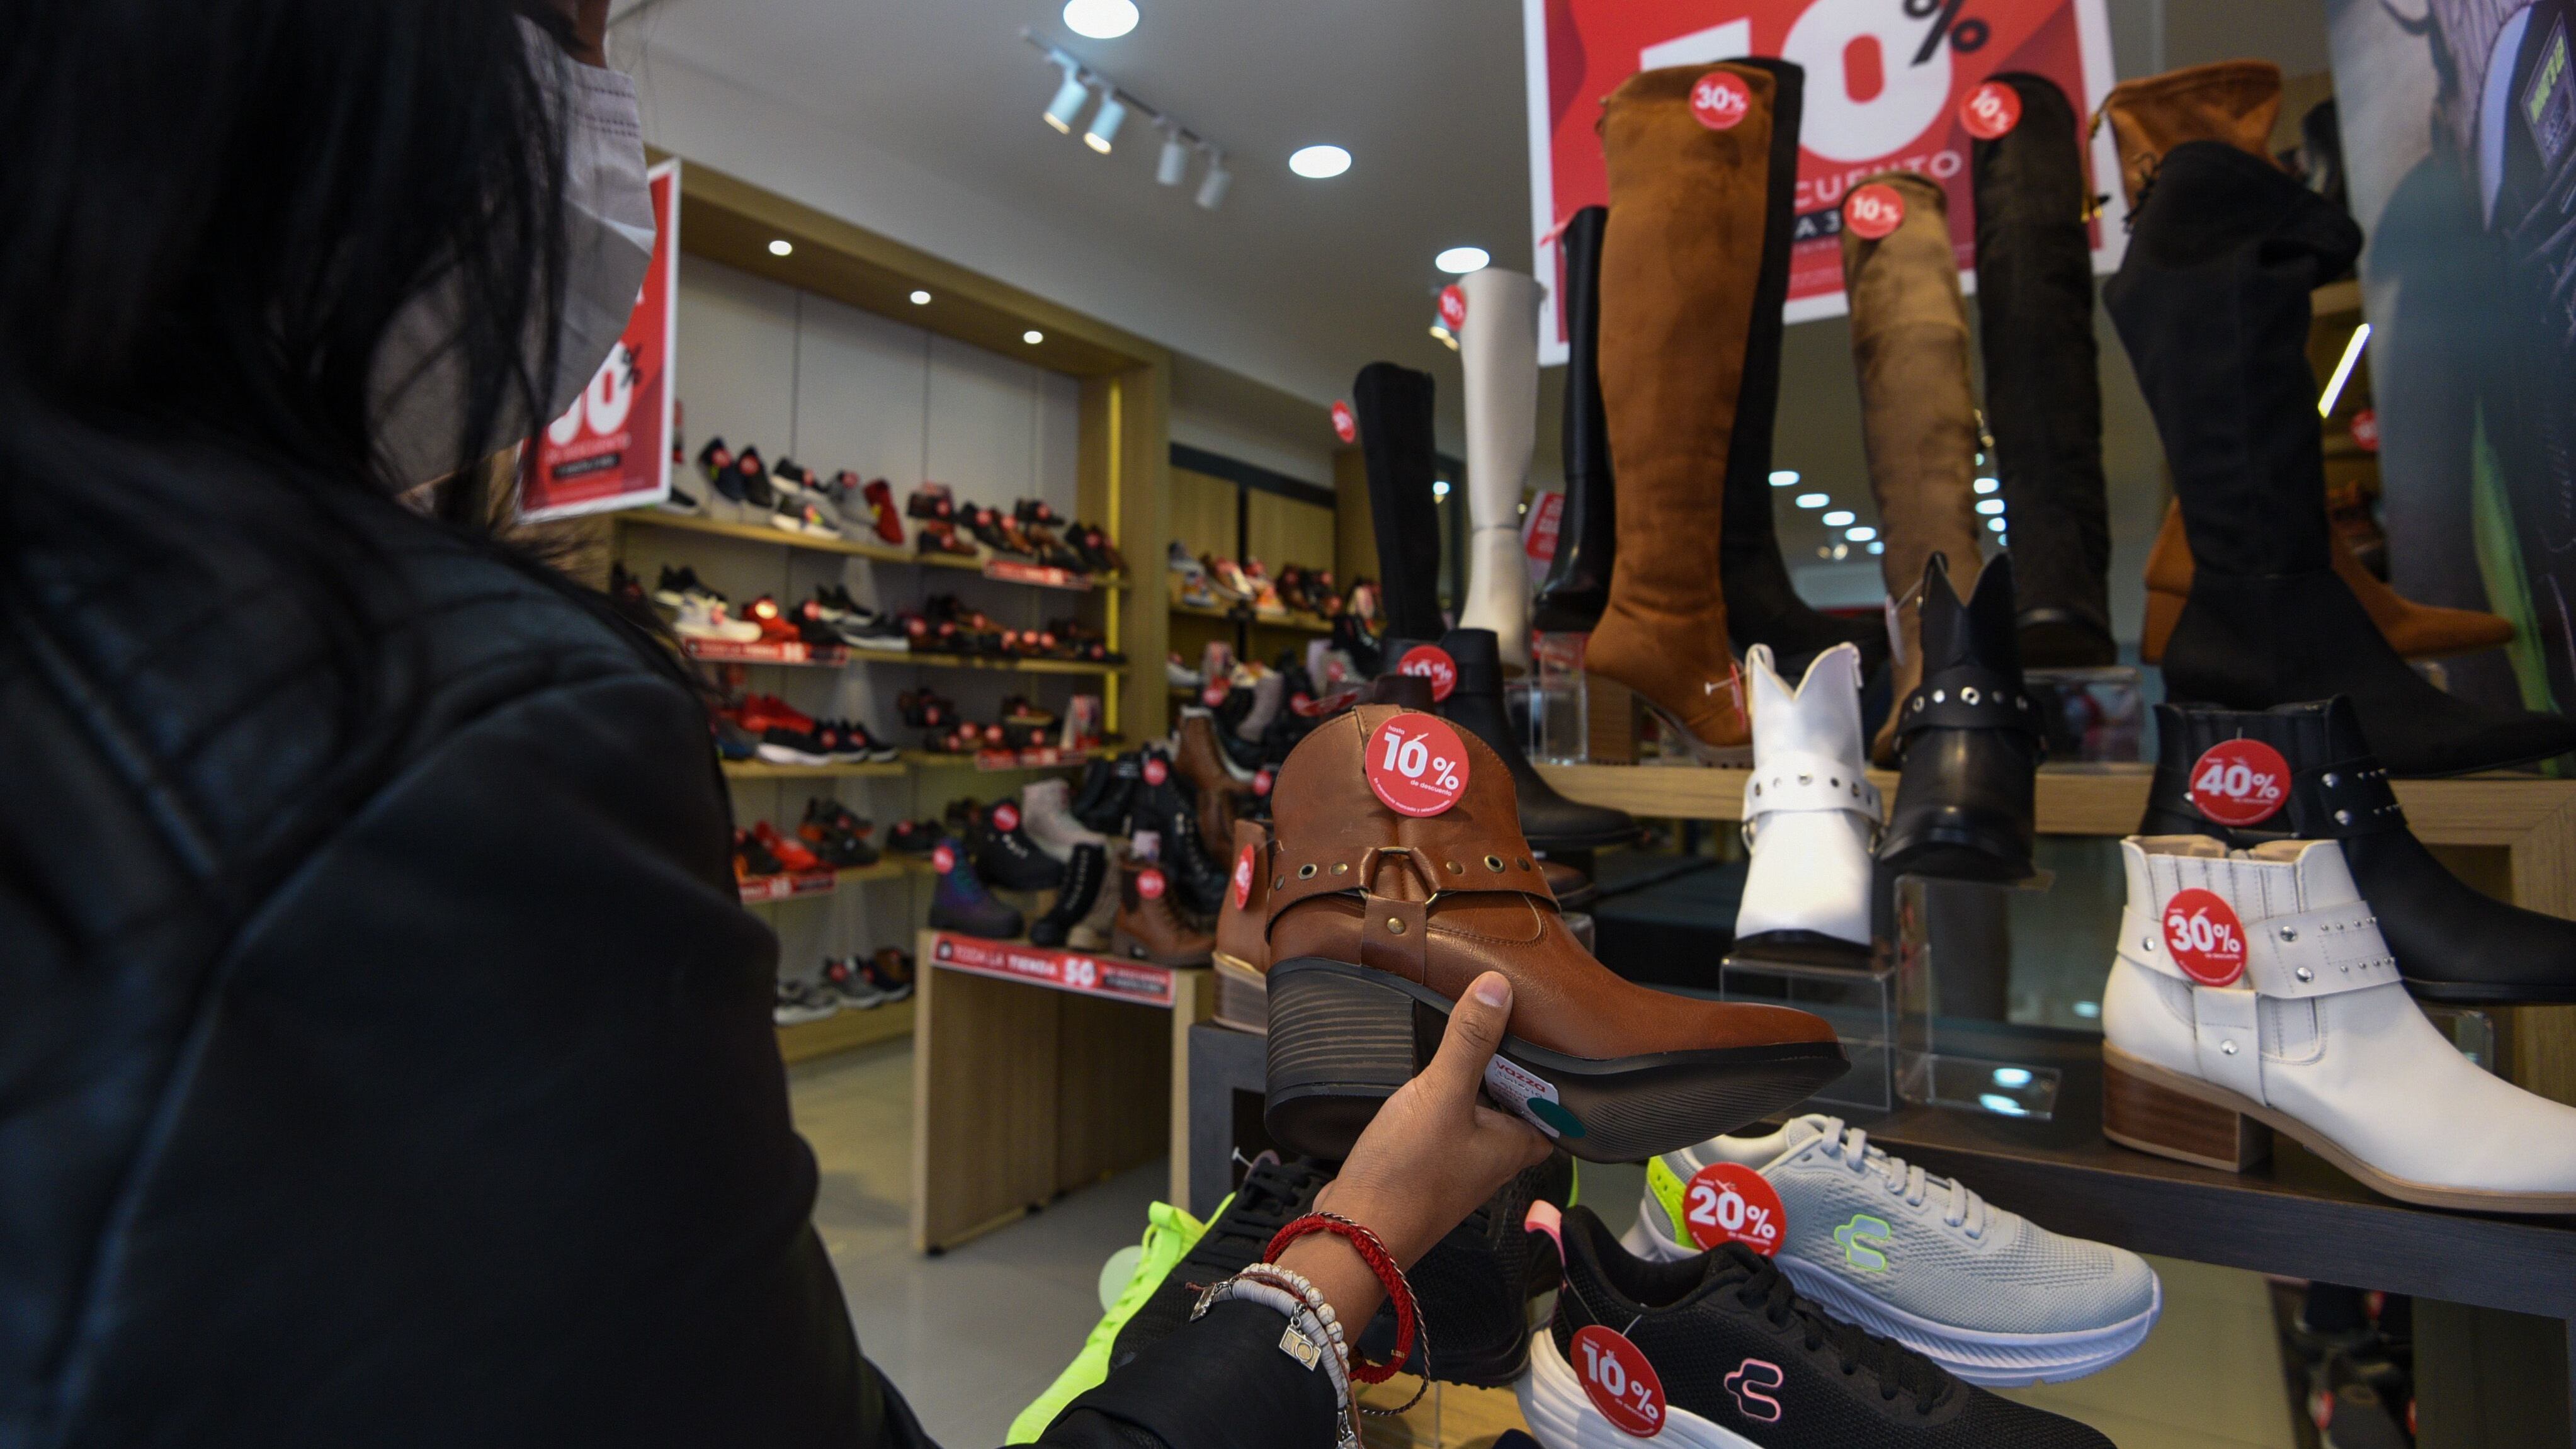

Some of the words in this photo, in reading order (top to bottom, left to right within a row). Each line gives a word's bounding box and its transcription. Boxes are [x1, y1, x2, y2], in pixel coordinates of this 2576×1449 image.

[1696, 83, 1747, 111] 30%
[1853, 198, 1898, 223] 10%
[1388, 725, 1405, 735] hasta
[1383, 732, 1459, 790] 10%
[1419, 782, 1452, 796] descuento
[2196, 764, 2281, 797] 40%
[2167, 914, 2241, 952] 30%
[1689, 1185, 1776, 1239] 20%
[1582, 1342, 1659, 1419] 10%
